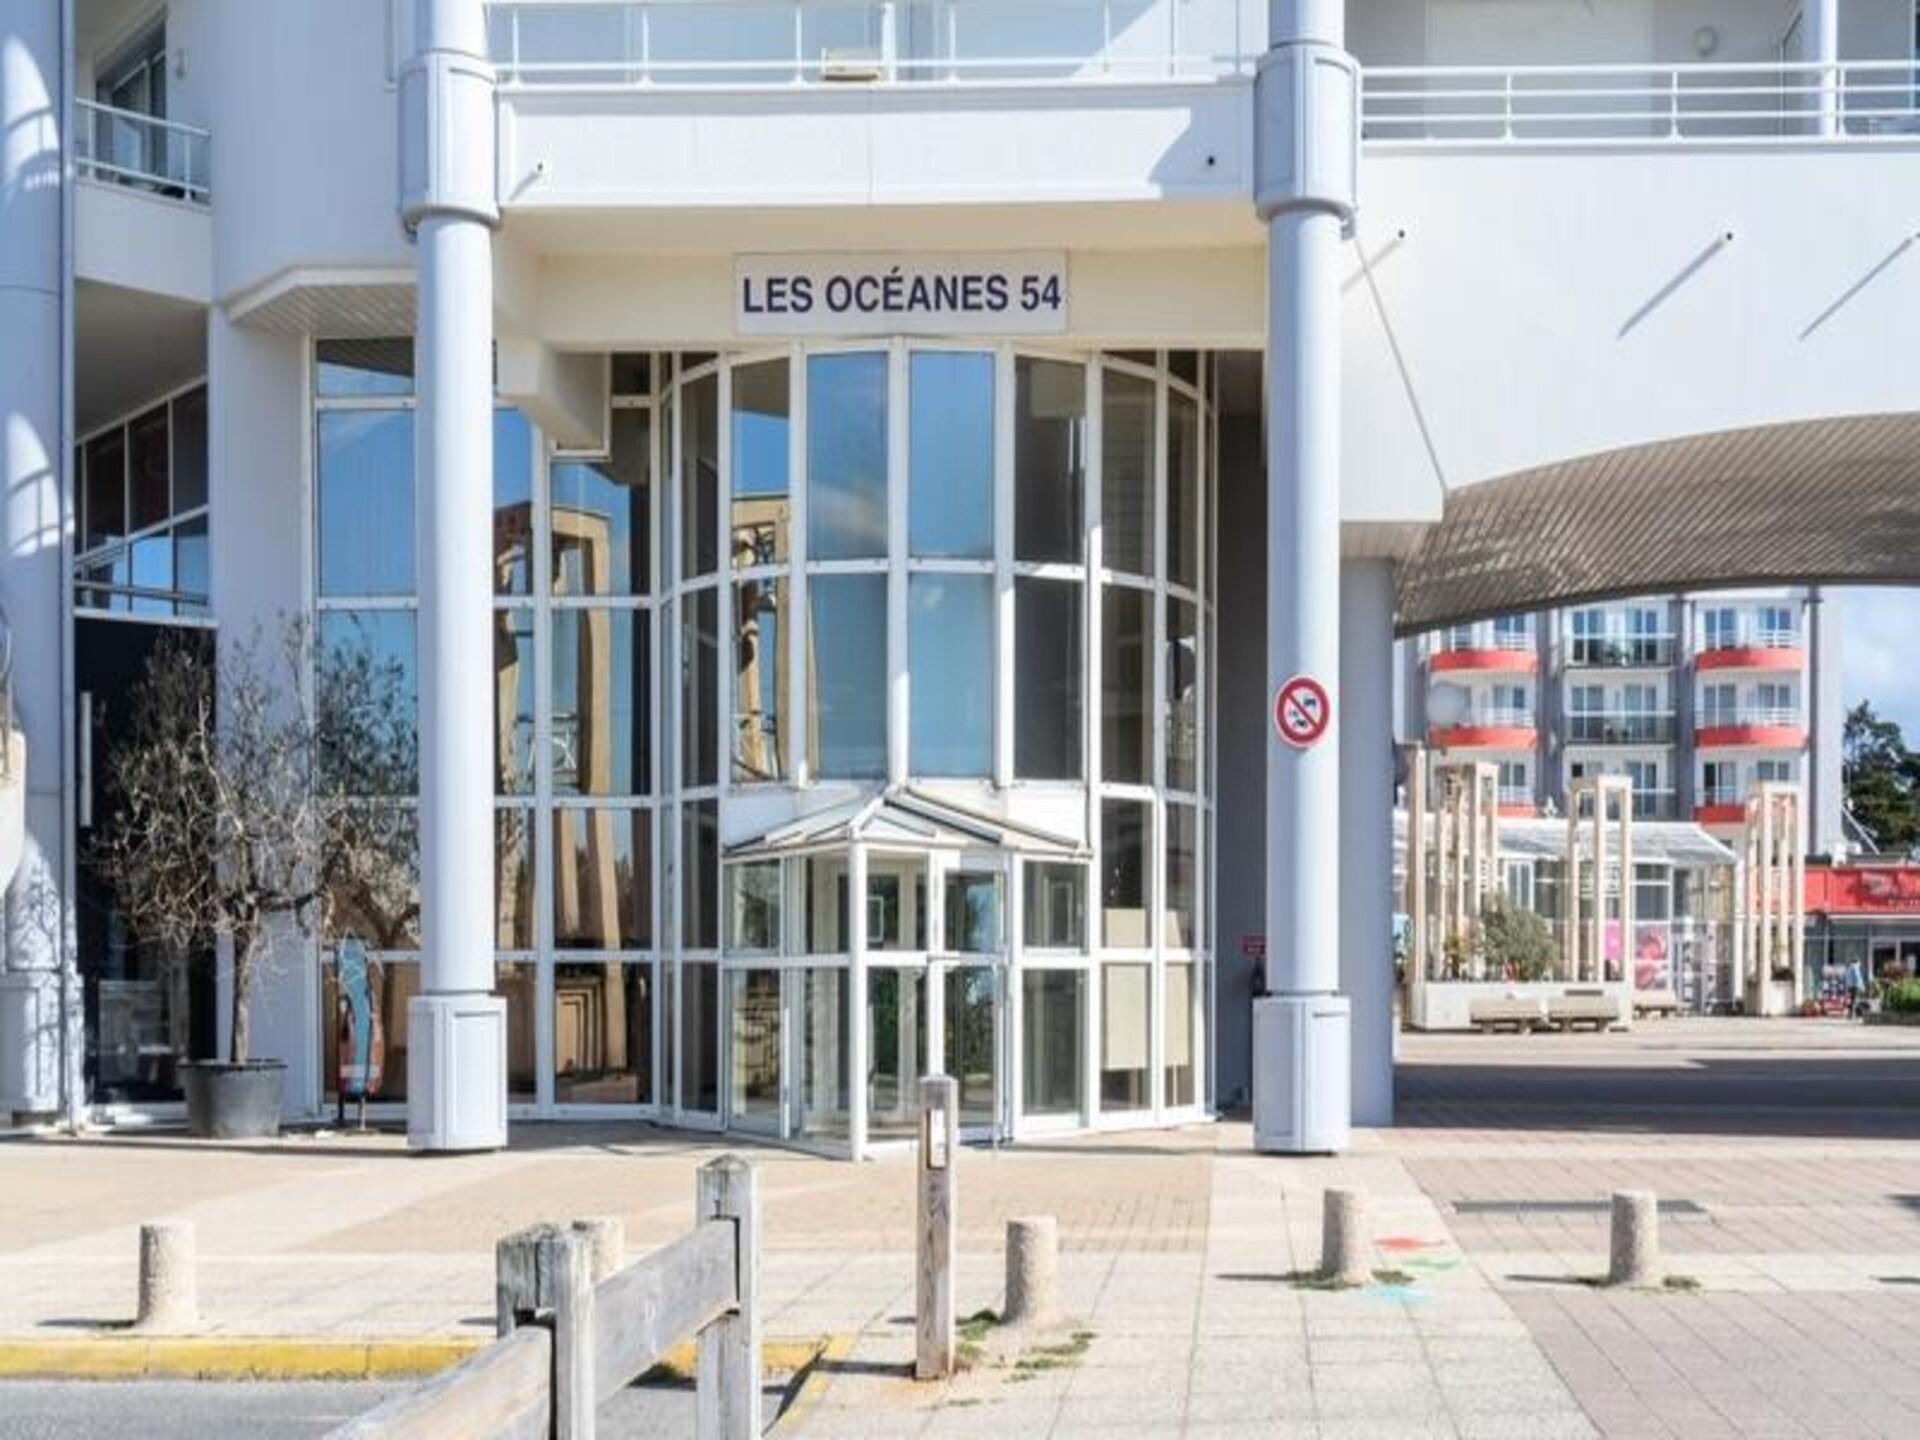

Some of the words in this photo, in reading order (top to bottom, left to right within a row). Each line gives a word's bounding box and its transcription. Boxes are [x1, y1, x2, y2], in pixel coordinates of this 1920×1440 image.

[743, 276, 813, 312] LES
[825, 266, 1009, 312] OCÉANES
[1020, 275, 1061, 311] 54
